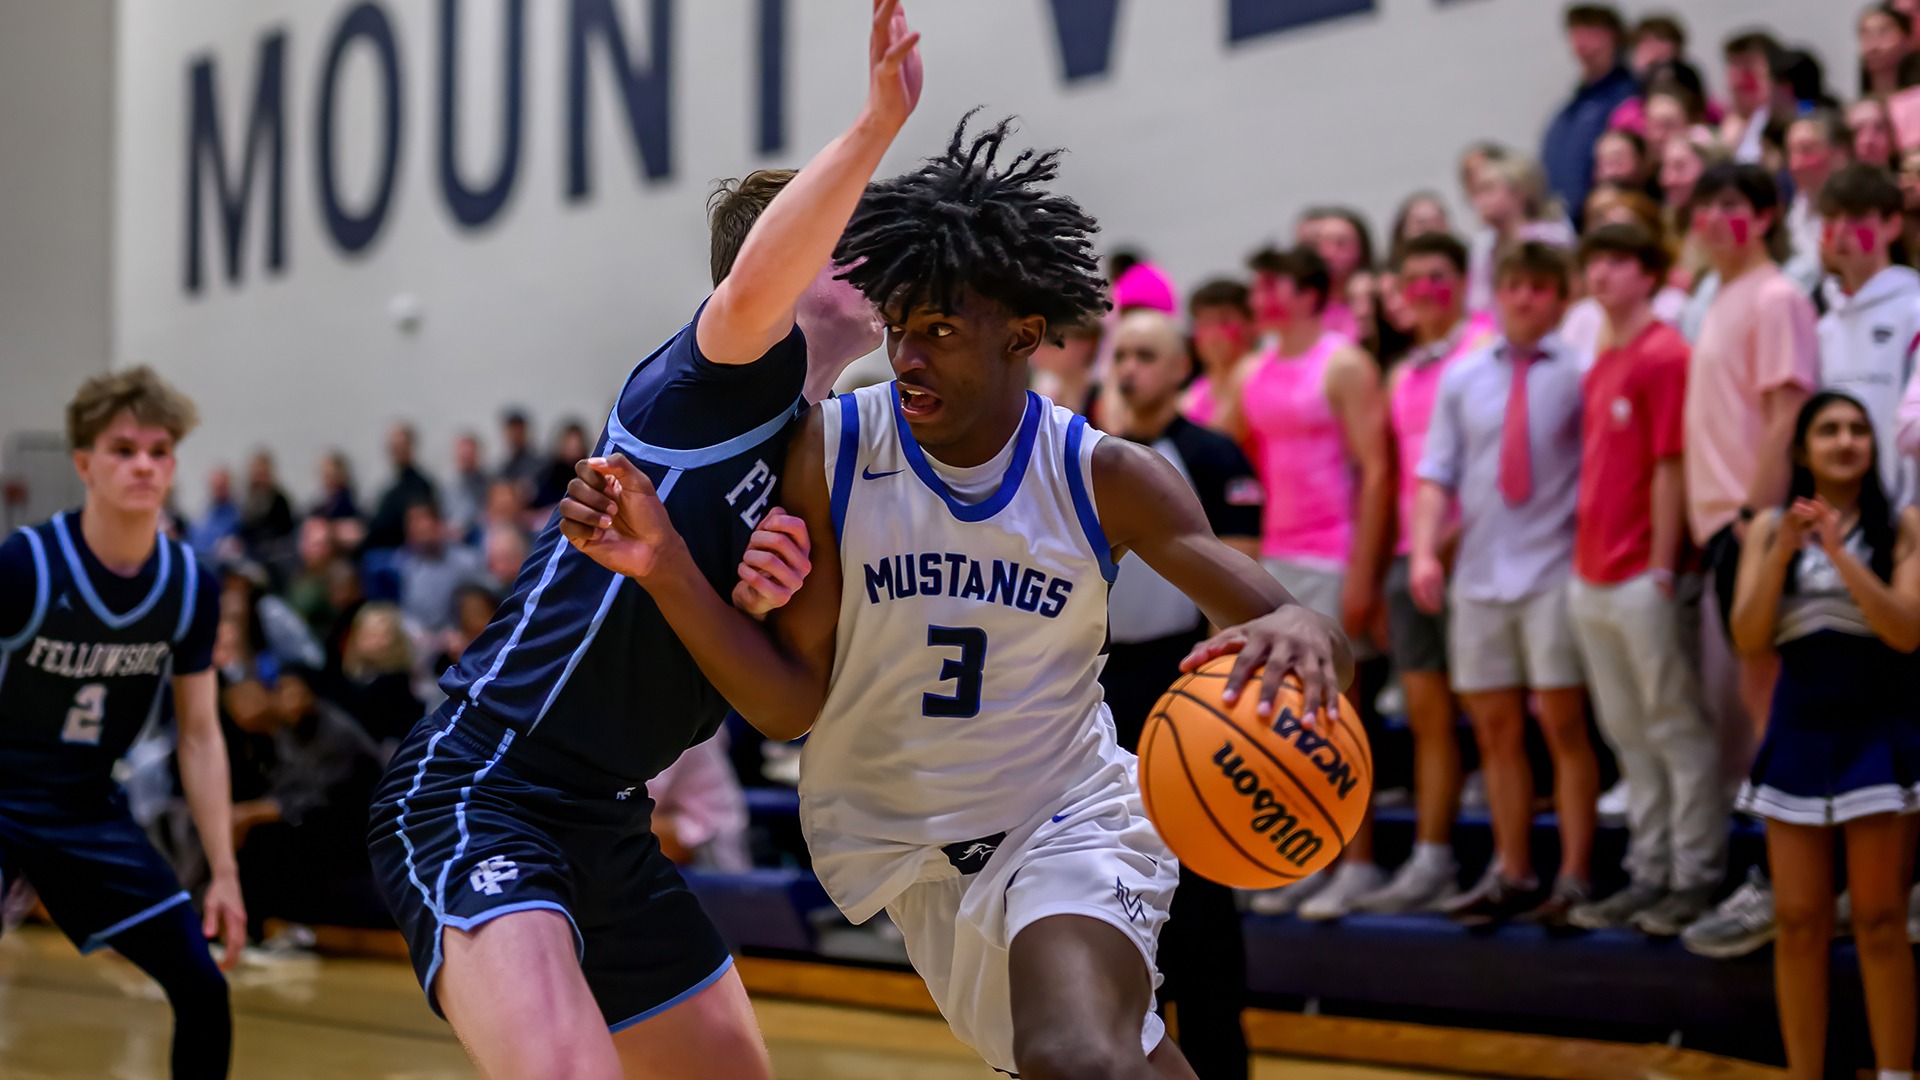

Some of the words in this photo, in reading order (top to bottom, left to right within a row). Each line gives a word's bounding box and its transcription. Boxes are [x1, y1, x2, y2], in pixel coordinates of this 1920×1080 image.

[863, 552, 1074, 619] MUSTANGS
[60, 682, 108, 745] 2
[922, 624, 988, 718] 3
[1272, 706, 1358, 800] NCAA
[1213, 740, 1323, 867] Wilson
